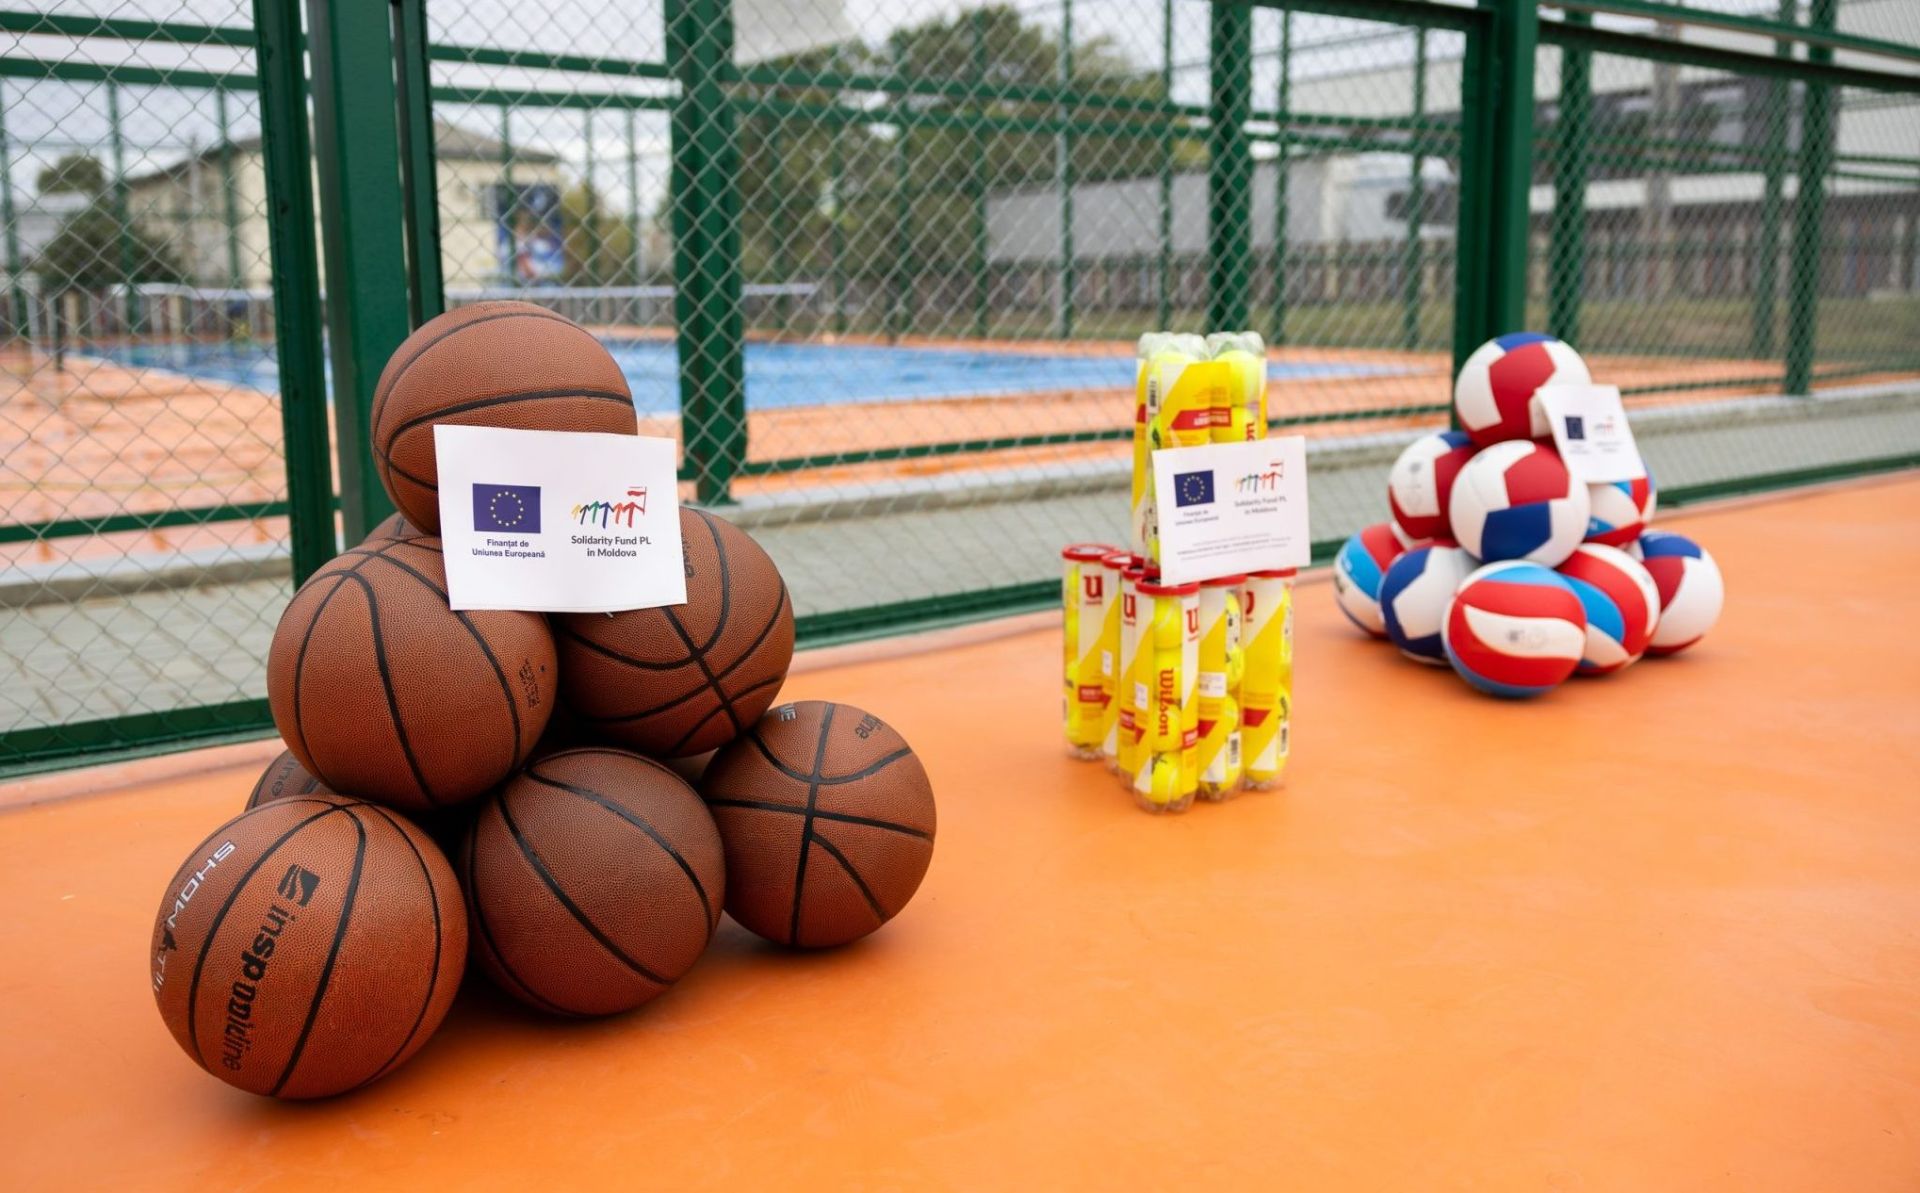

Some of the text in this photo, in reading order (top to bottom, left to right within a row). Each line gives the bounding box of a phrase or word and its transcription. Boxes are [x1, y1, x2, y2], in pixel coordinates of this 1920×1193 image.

[520, 540, 529, 548] de
[571, 535, 652, 546] Solidarity Fund PL
[472, 548, 503, 556] Uniunea
[587, 548, 637, 557] in Moldova
[1158, 667, 1175, 736] Wilson
[167, 840, 236, 929] SHOW
